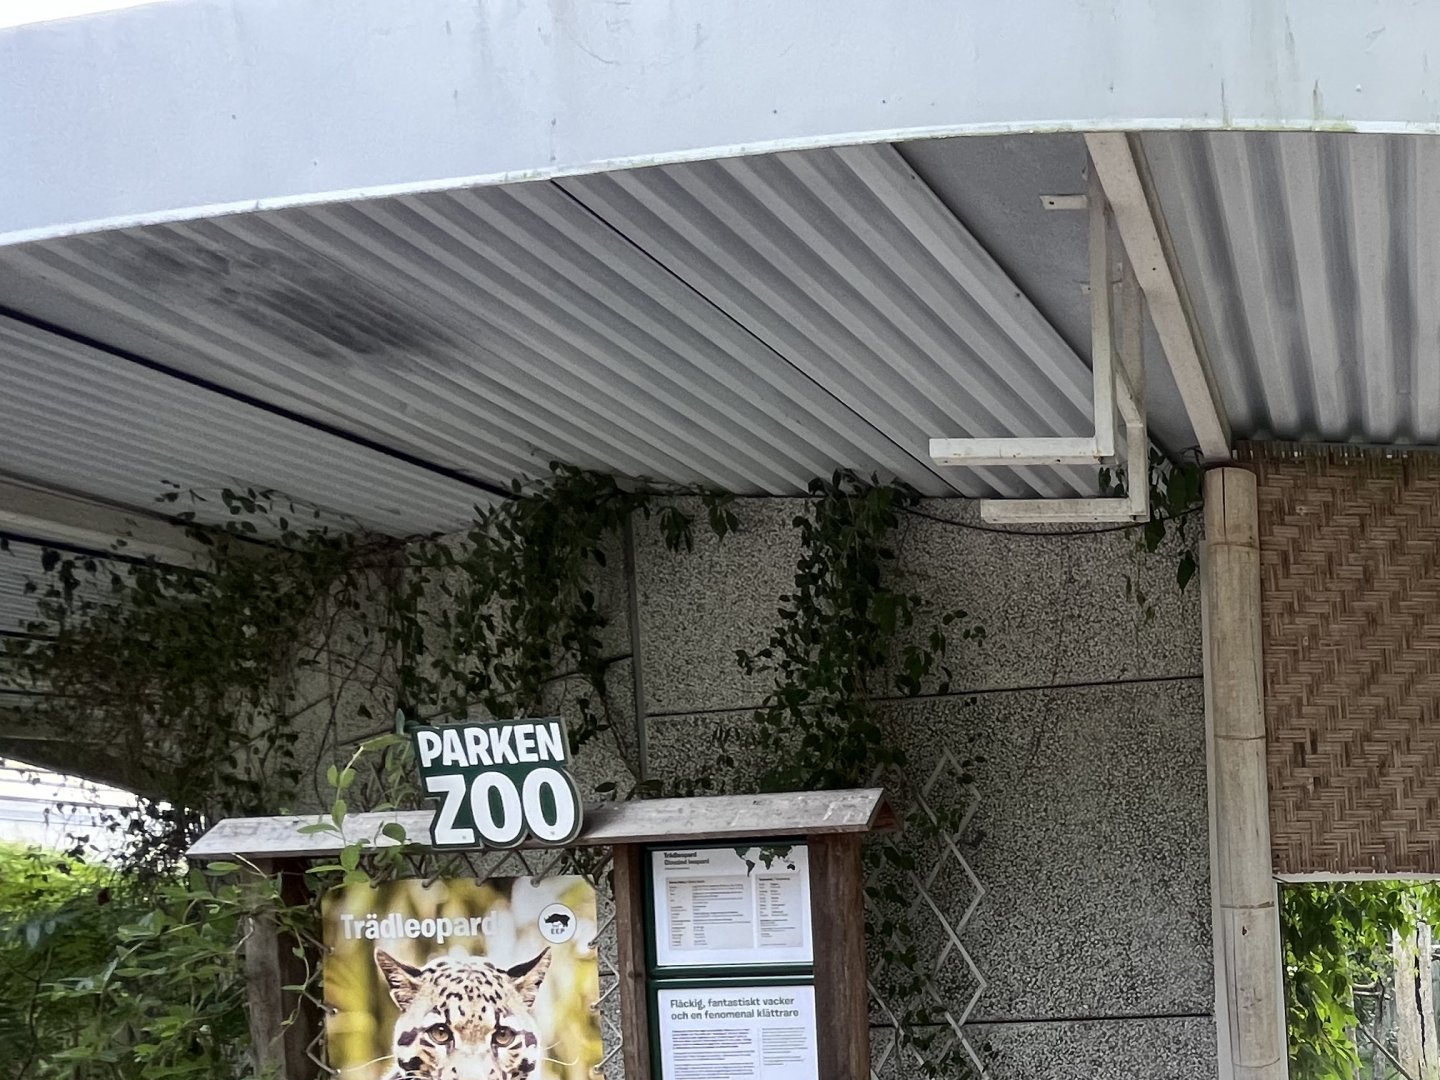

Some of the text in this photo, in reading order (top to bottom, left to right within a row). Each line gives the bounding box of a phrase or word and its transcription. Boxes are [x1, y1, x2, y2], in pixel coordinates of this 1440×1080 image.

[417, 722, 565, 768] PARKEN
[425, 767, 575, 845] ZOO
[340, 911, 500, 944] Trädleopard
[670, 996, 795, 1010] Fläckig, fantastiskt vacker
[671, 1008, 799, 1020] och en fenomenal klättrare
